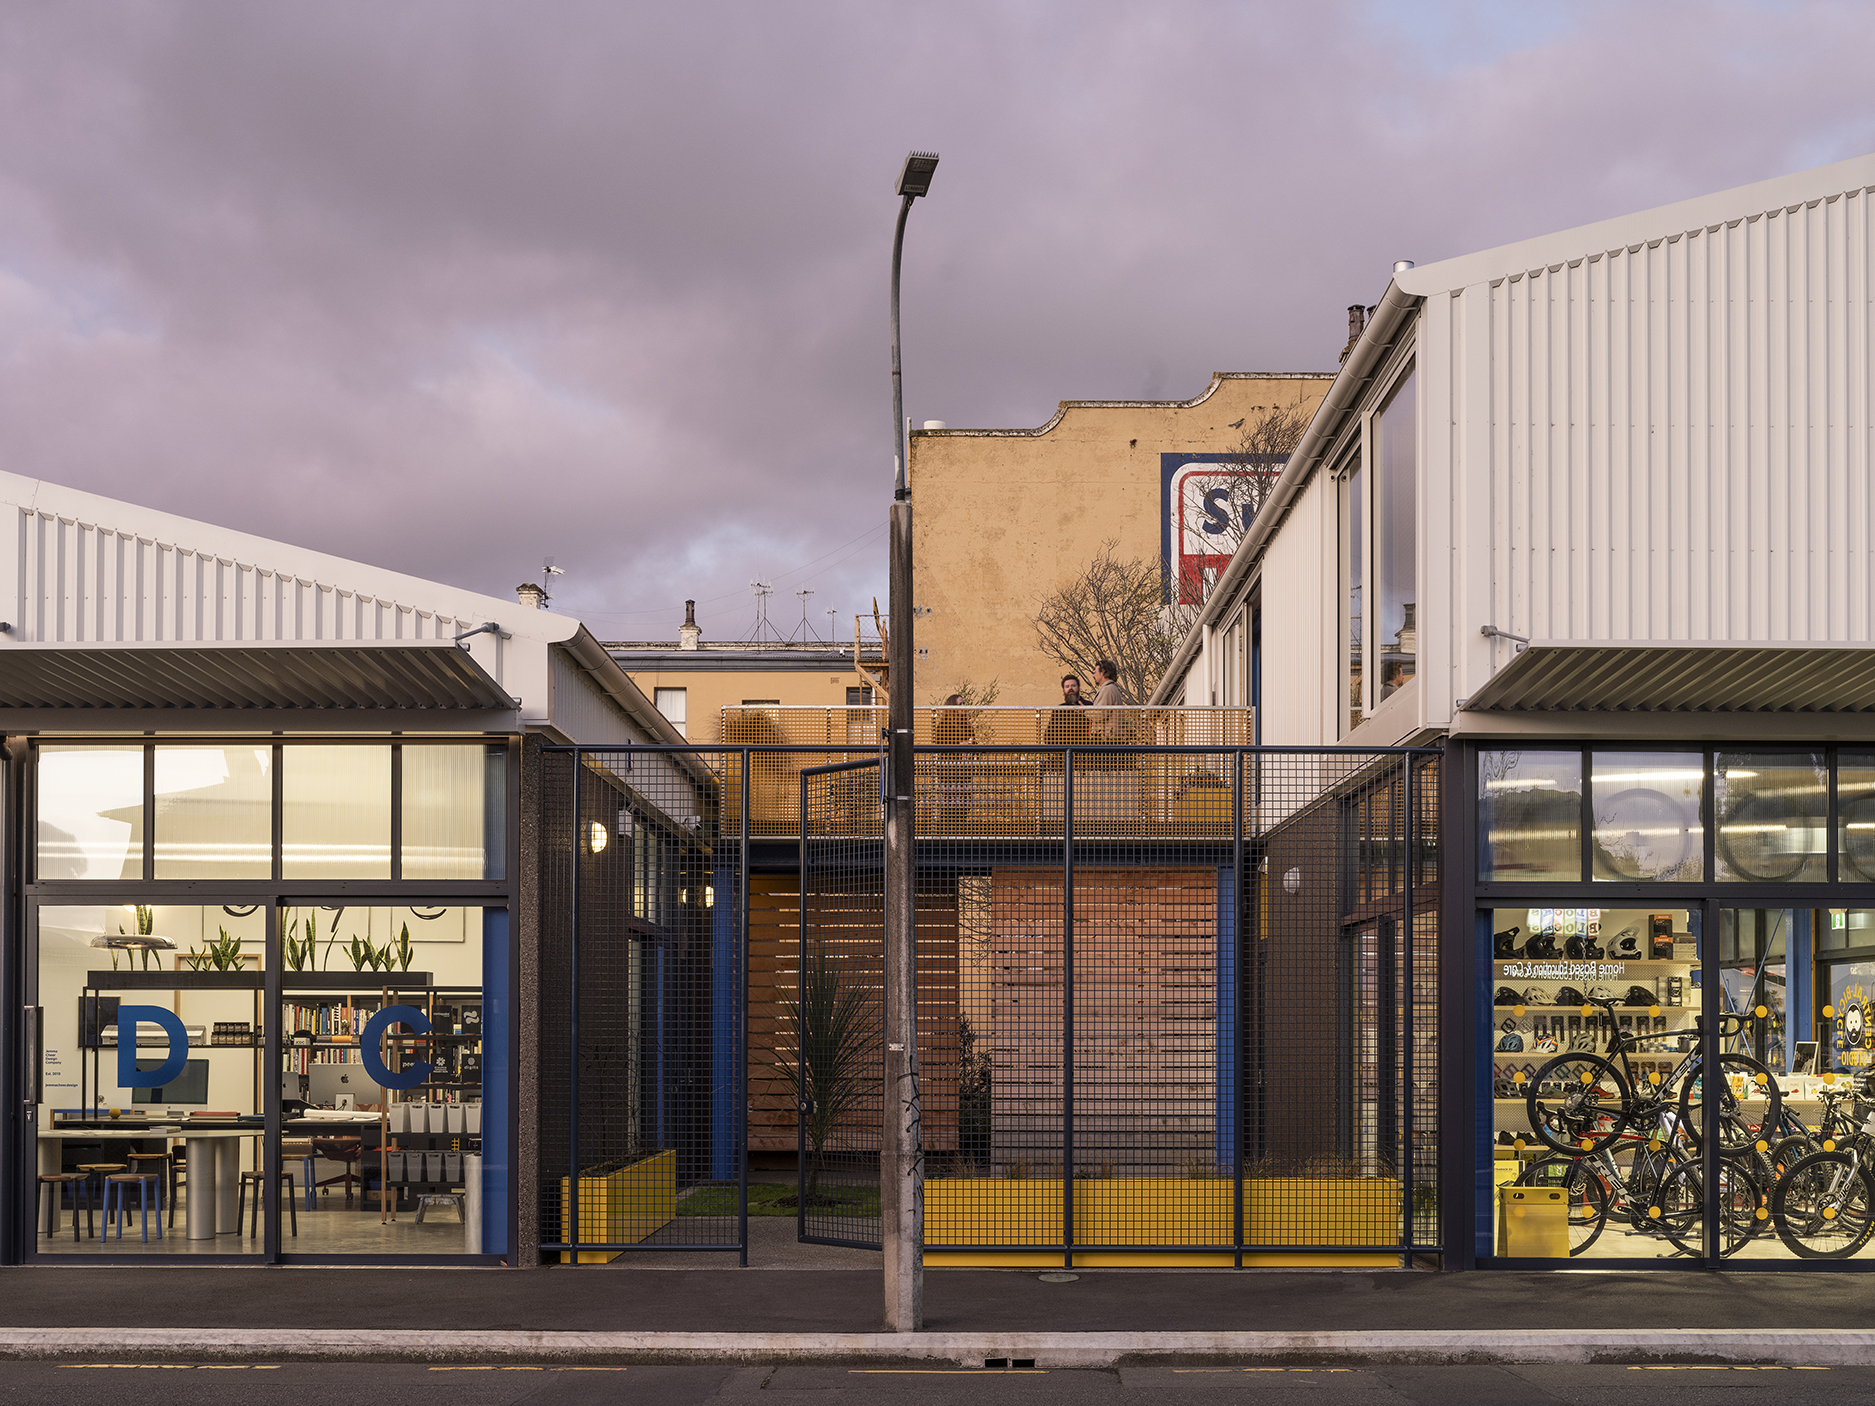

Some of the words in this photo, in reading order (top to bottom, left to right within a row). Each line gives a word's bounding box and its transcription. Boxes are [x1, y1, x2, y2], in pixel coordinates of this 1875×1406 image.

[117, 1005, 189, 1088] D
[360, 1004, 434, 1091] C
[1653, 1049, 1700, 1102] TREK
[1586, 1153, 1636, 1206] TREK
